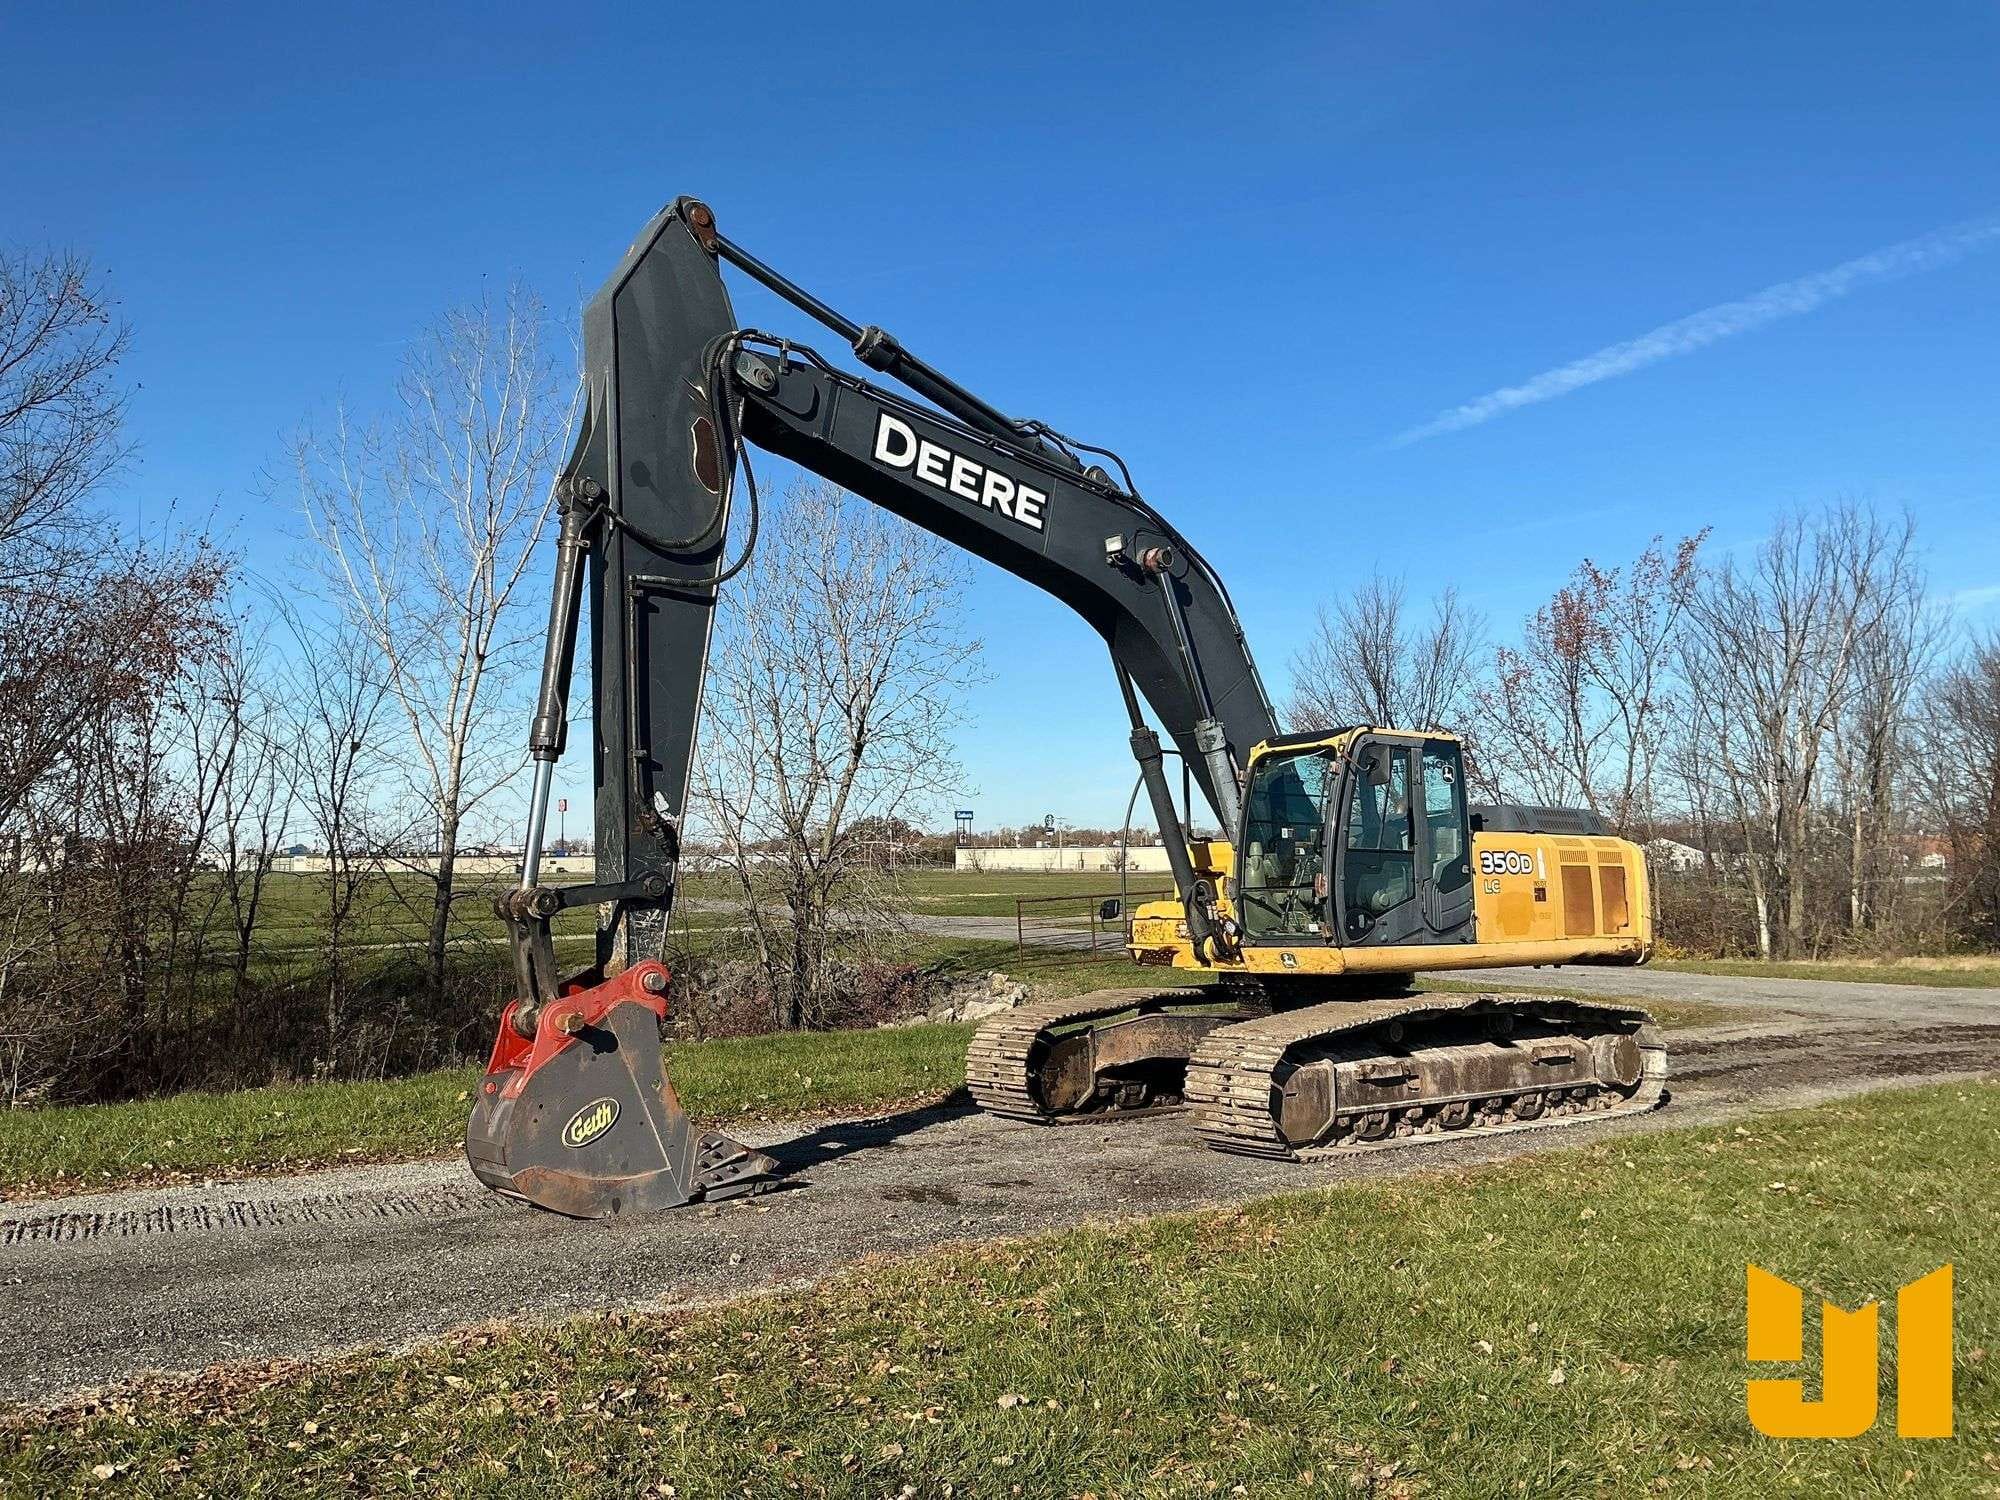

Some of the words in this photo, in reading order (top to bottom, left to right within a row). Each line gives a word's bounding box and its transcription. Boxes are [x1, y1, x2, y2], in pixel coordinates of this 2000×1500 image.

[875, 413, 1046, 530] DEERE
[1480, 851, 1533, 874] 350D
[1484, 879, 1501, 894] LC
[571, 1102, 612, 1142] Geith
